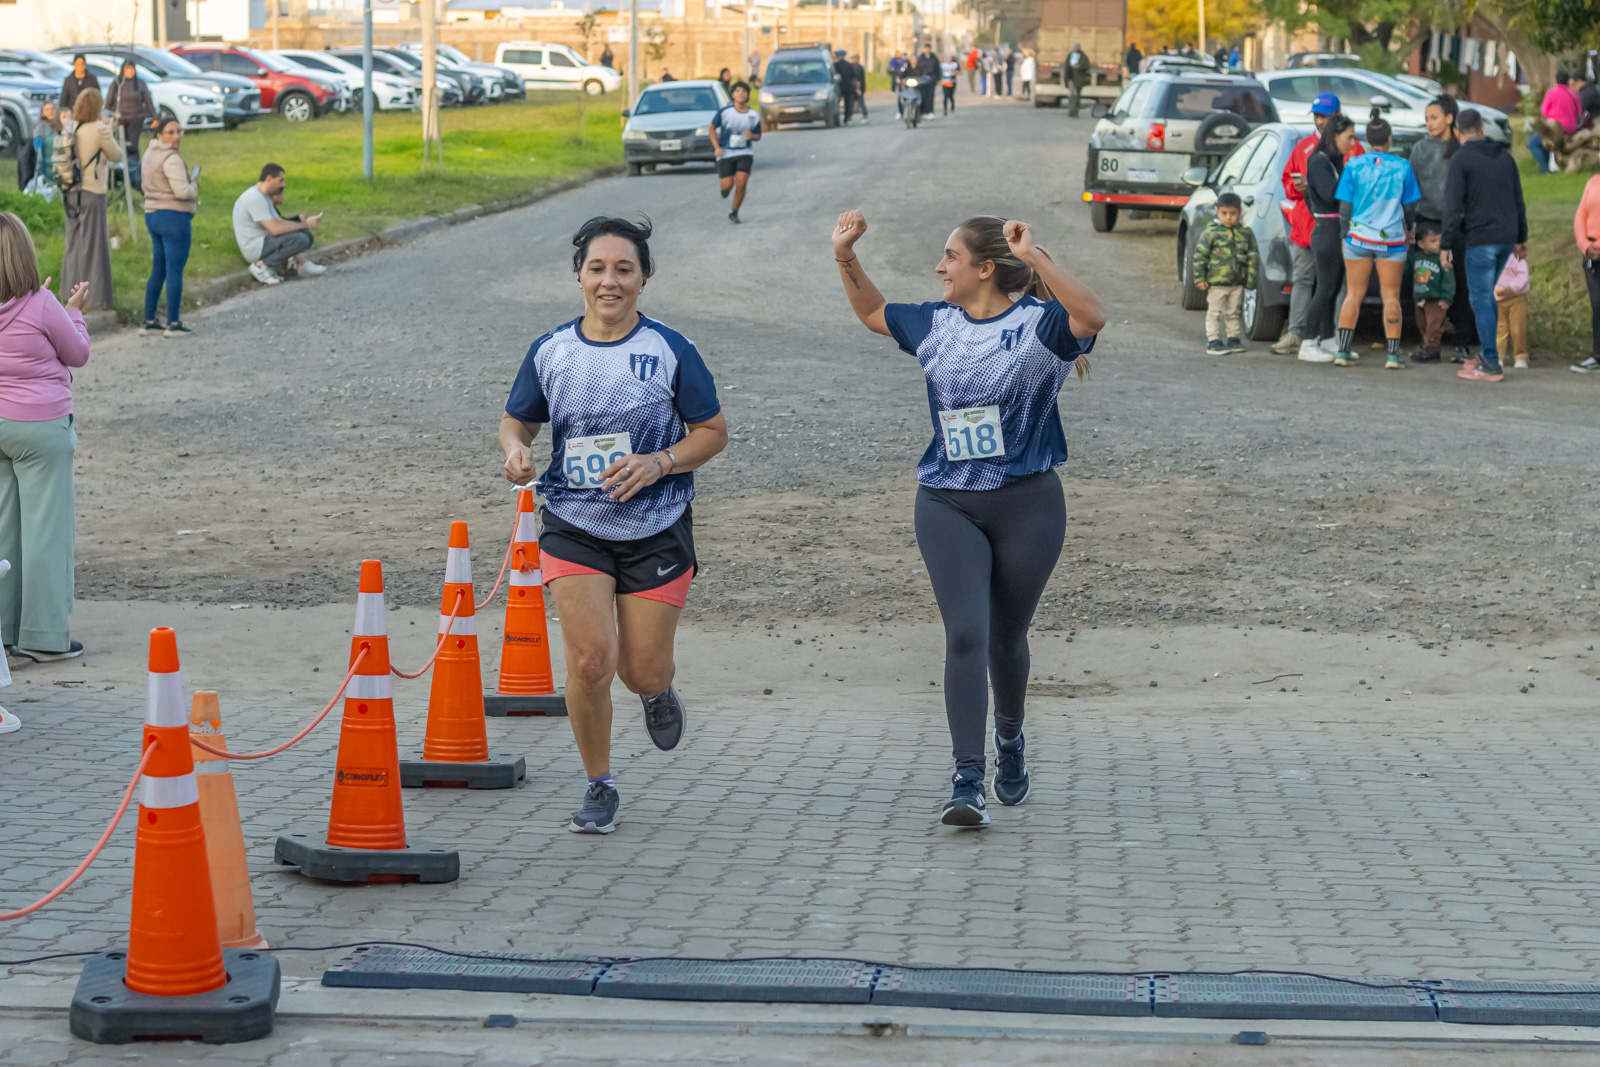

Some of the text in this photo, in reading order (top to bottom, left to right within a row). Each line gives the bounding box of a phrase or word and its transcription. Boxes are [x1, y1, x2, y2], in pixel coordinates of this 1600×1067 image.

[1101, 158, 1119, 172] 80
[634, 355, 654, 364] SFC
[947, 423, 998, 458] 518
[344, 773, 385, 781] CONOFLEX
